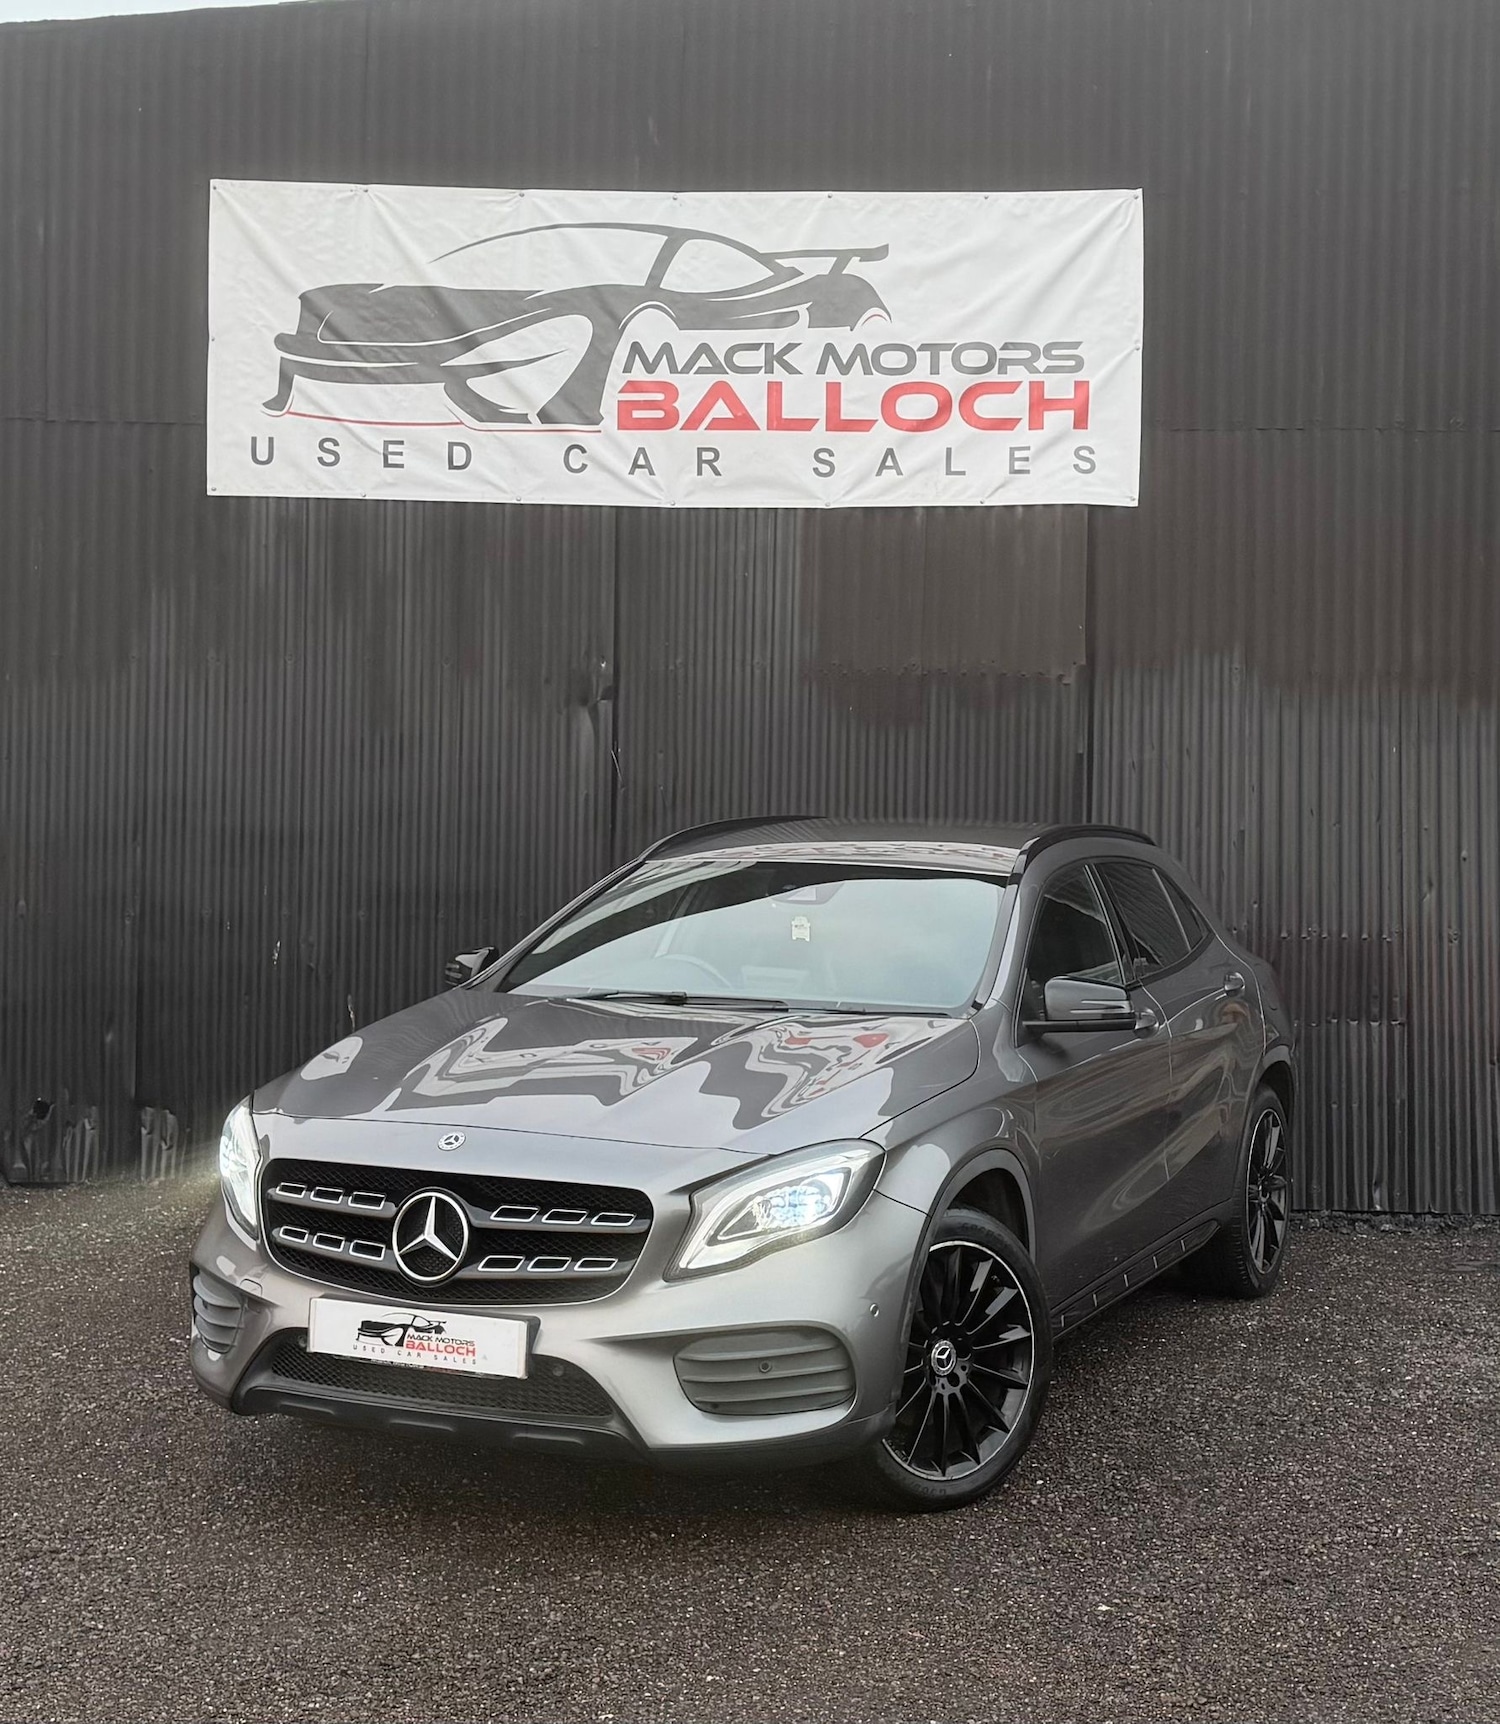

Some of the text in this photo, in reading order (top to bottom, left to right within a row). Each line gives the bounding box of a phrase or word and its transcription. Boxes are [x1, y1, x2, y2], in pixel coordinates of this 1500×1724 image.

[622, 341, 1086, 376] MACK MOTORS
[616, 380, 1090, 432] BALLOCH
[250, 436, 1097, 478] USED CAR SALES
[353, 1344, 386, 1354] USED
[397, 1350, 422, 1358] CAR
[433, 1354, 477, 1365] SALES
[405, 1340, 476, 1357] BALLOCH
[407, 1334, 476, 1347] MACK MOTORS
